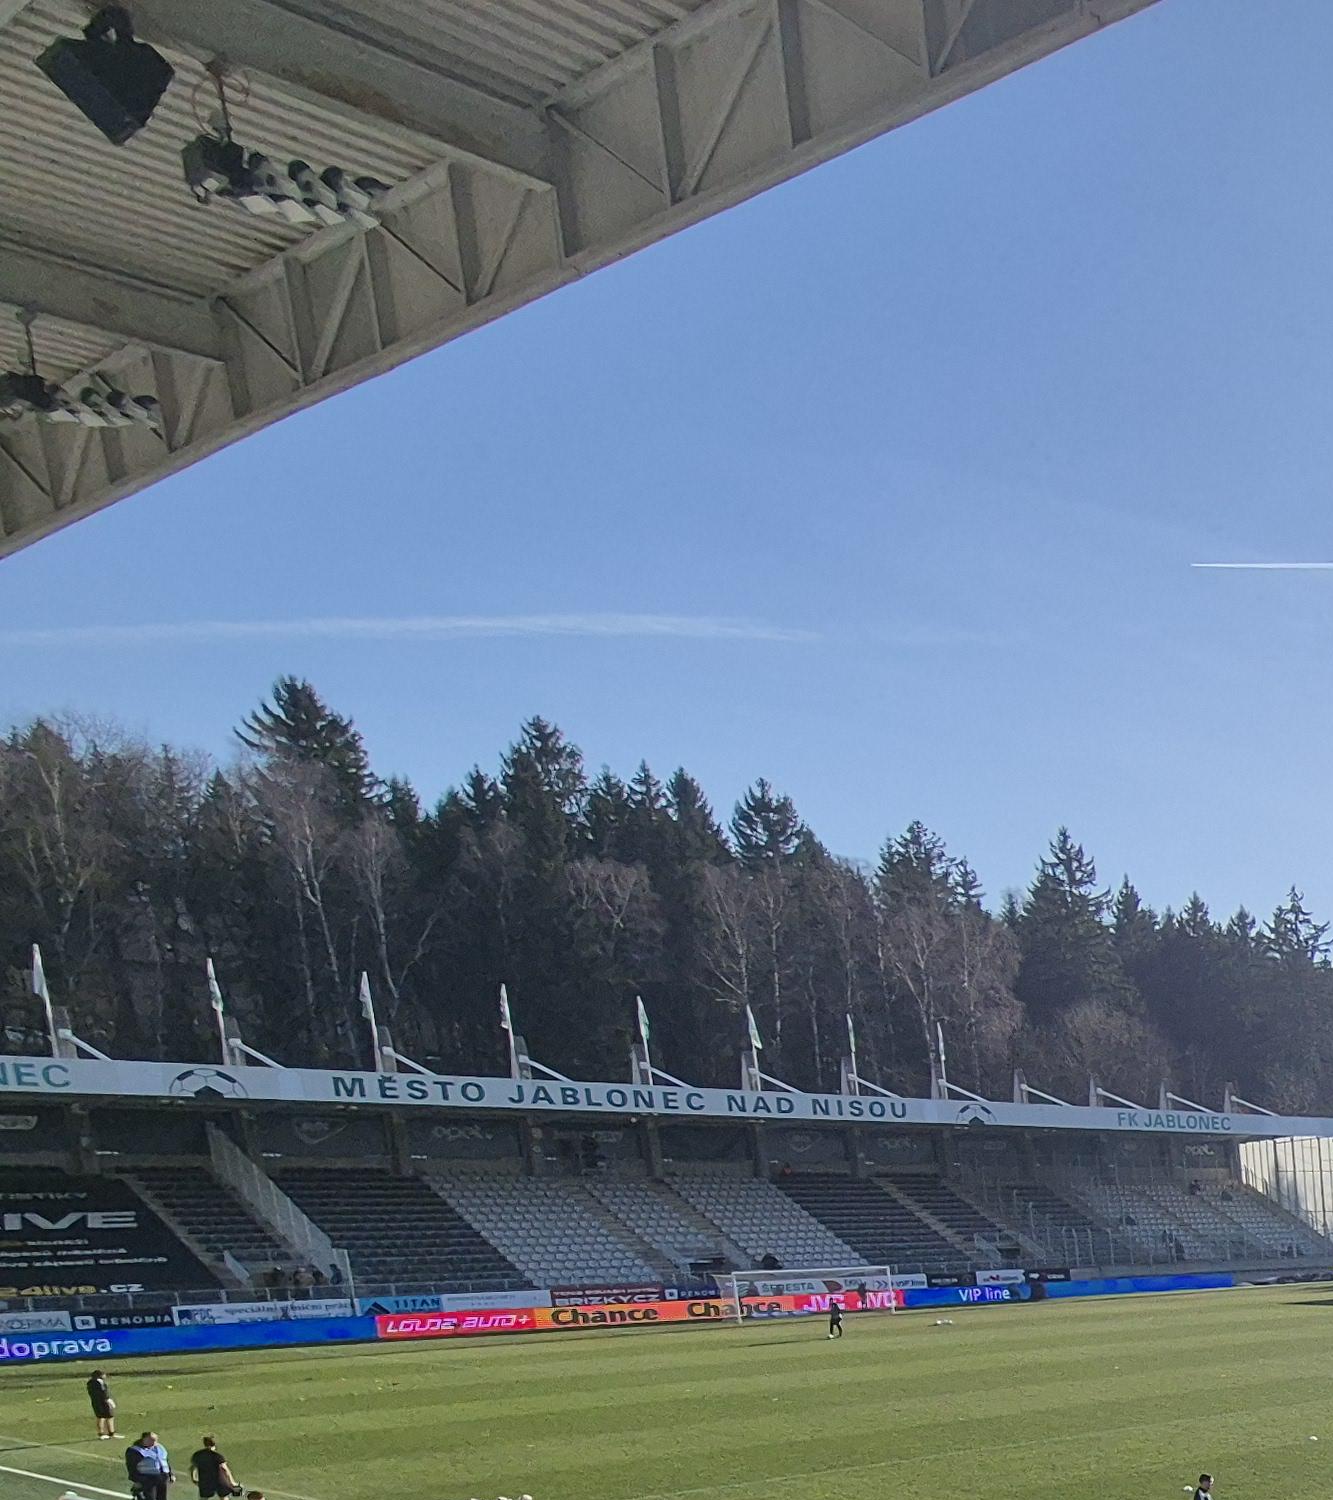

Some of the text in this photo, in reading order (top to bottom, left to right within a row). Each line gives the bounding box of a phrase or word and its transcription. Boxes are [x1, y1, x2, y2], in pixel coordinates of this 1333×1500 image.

[332, 1075, 907, 1118] MĚSTO JABLONEC NAD NISOU
[1117, 1112, 1231, 1131] FK JABLONEC
[0, 1210, 138, 1231] IVE
[393, 1297, 440, 1308] TITAN
[959, 1287, 1010, 1302] VIP line
[551, 1308, 659, 1327] Chance
[687, 1302, 781, 1319] Chance
[100, 1314, 173, 1326] RENOMIA
